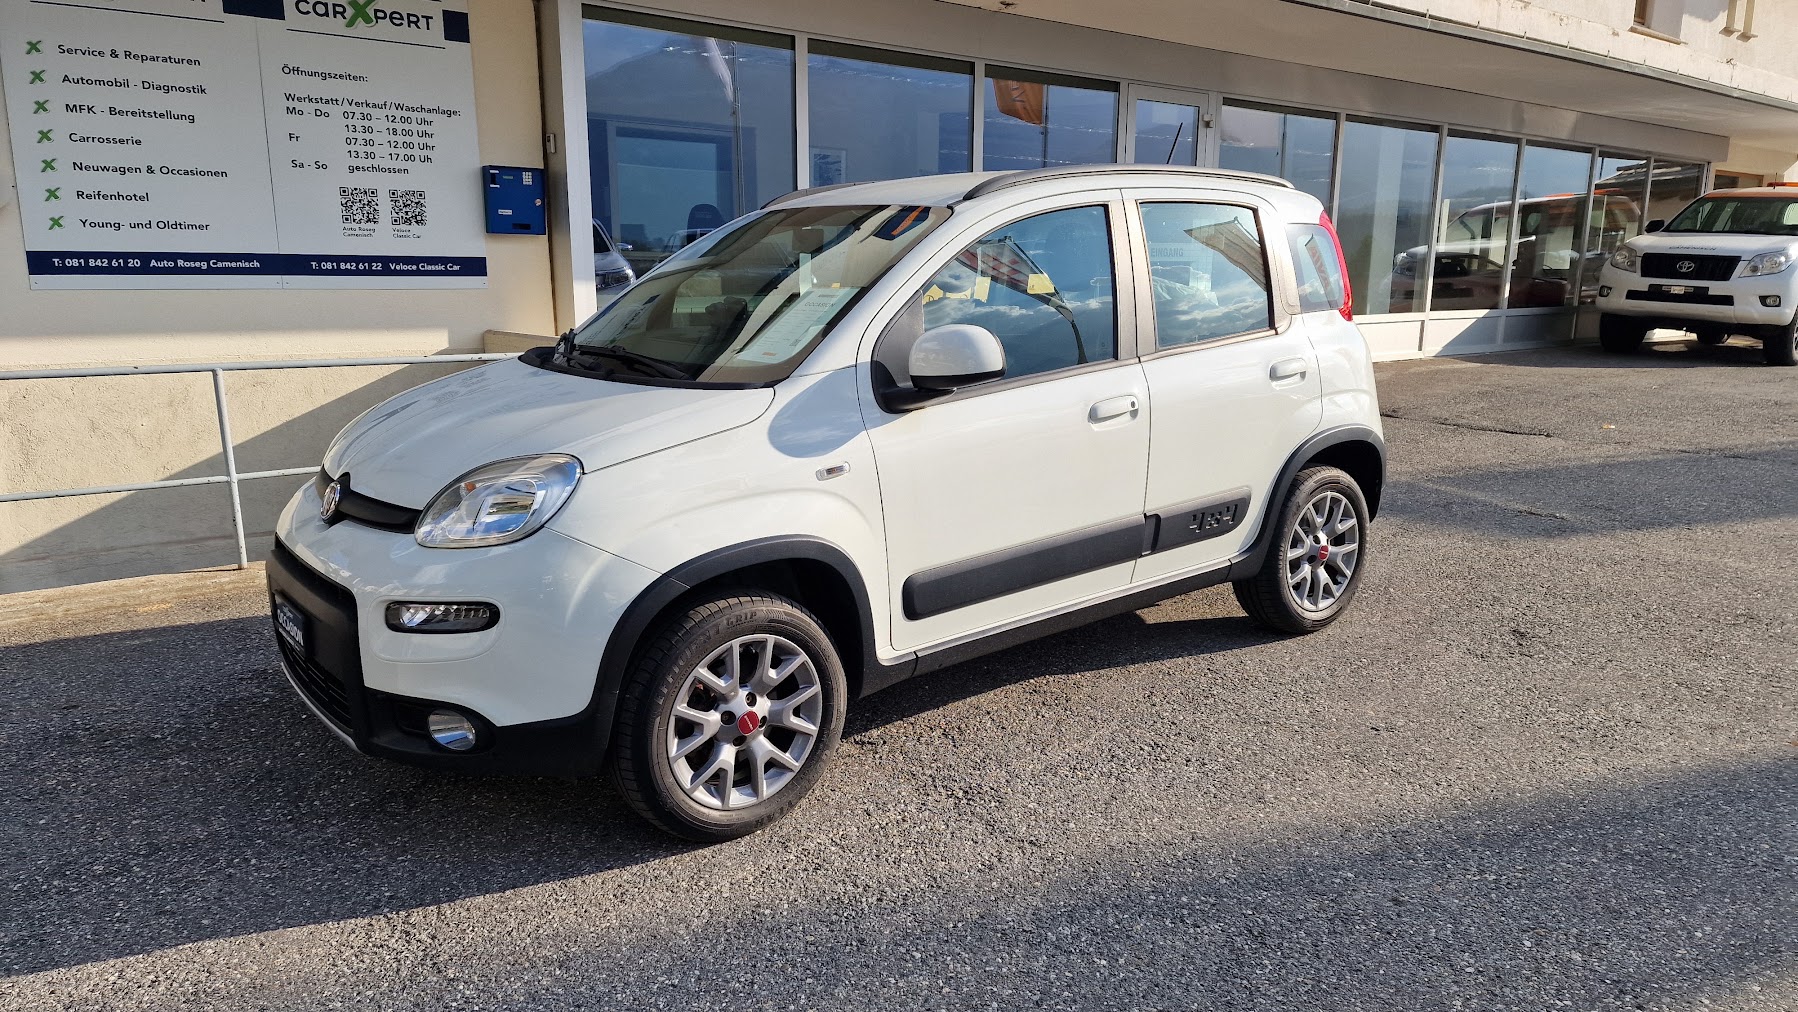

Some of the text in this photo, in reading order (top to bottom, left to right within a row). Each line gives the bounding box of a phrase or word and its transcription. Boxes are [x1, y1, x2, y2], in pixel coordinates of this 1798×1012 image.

[57, 44, 201, 67] Service & Reparaturen
[281, 64, 368, 82] Öffnungszeiten:
[61, 74, 130, 89] Automobil
[141, 80, 207, 95] Diagnostik
[65, 103, 97, 115] MFK
[108, 106, 195, 123] Bereitstellung
[286, 106, 304, 116] Mo
[314, 108, 330, 118] Do
[342, 111, 373, 122] 07.30
[385, 114, 413, 125] 12.00
[415, 117, 434, 127] Uhr
[68, 132, 142, 146] Carrosserie
[345, 124, 374, 134] 13.30
[386, 127, 414, 137] 18.00
[416, 129, 435, 139] Uhr
[288, 132, 300, 142] Fr
[345, 137, 375, 147] 07.30
[387, 140, 415, 150] 12.00
[417, 142, 436, 151] Uhr
[347, 150, 376, 160] 13.30
[388, 153, 416, 162] 17.00
[418, 154, 433, 164] Uh
[72, 161, 228, 178] Neuwagen & Occasionen
[291, 160, 304, 169] Sa
[314, 161, 328, 170] So
[348, 163, 409, 175] geschlossen
[76, 190, 149, 202] Reifenhotel
[79, 218, 210, 232] Young- und Oldtimer
[1151, 247, 1184, 258] EINGANG
[52, 258, 260, 269] T: 081 842 61 20 Auto Roseg Camenisch
[310, 262, 461, 271] T: 081 842 61 22 Veloce Classic Car
